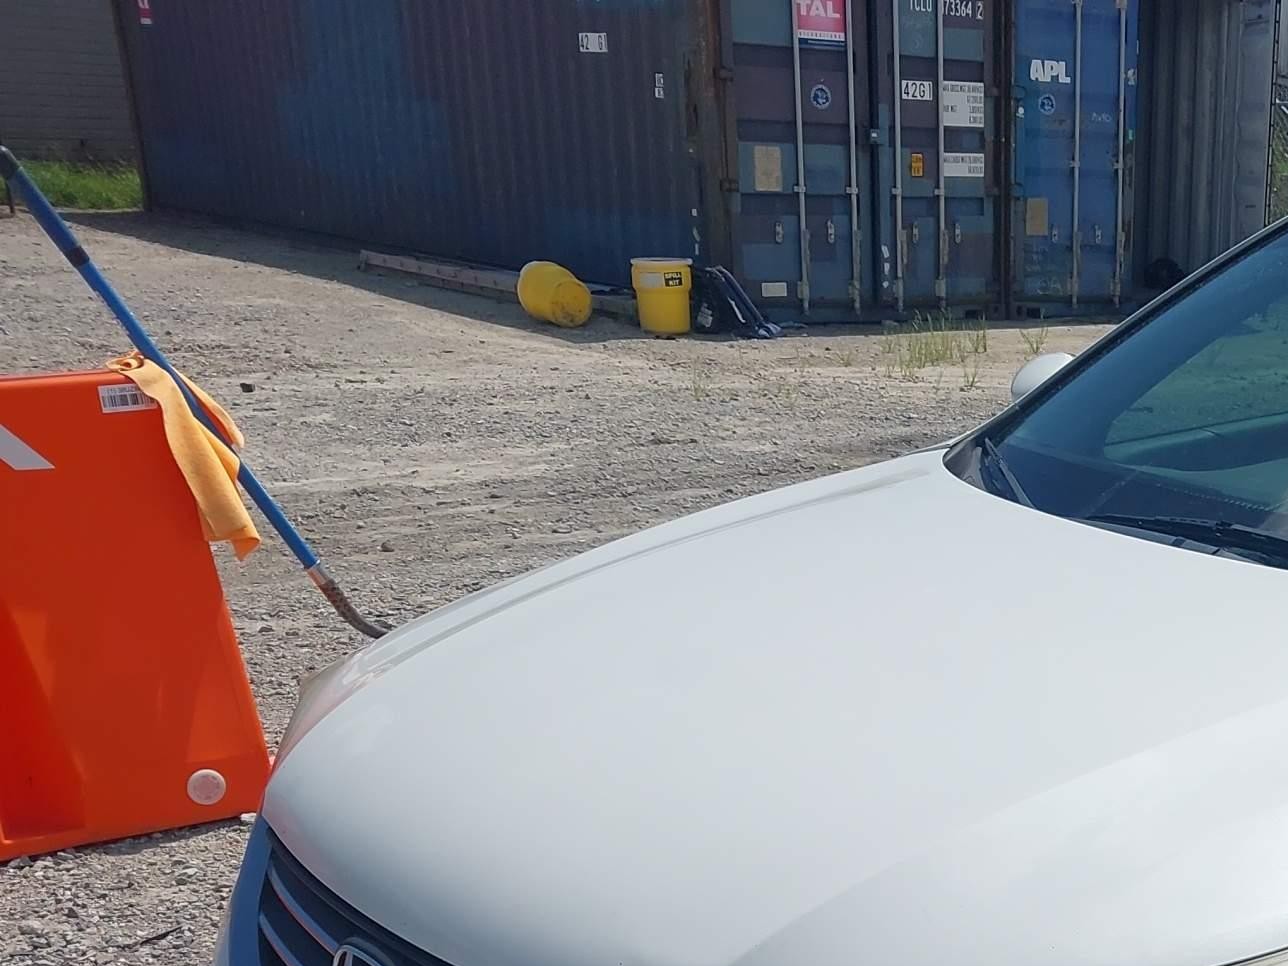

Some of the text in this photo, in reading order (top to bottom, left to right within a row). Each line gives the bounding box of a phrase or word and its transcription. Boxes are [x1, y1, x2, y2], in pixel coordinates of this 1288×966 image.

[797, 0, 841, 18] TAL
[580, 34, 590, 51] 42
[1030, 60, 1071, 83] APL
[903, 81, 932, 99] 42G1
